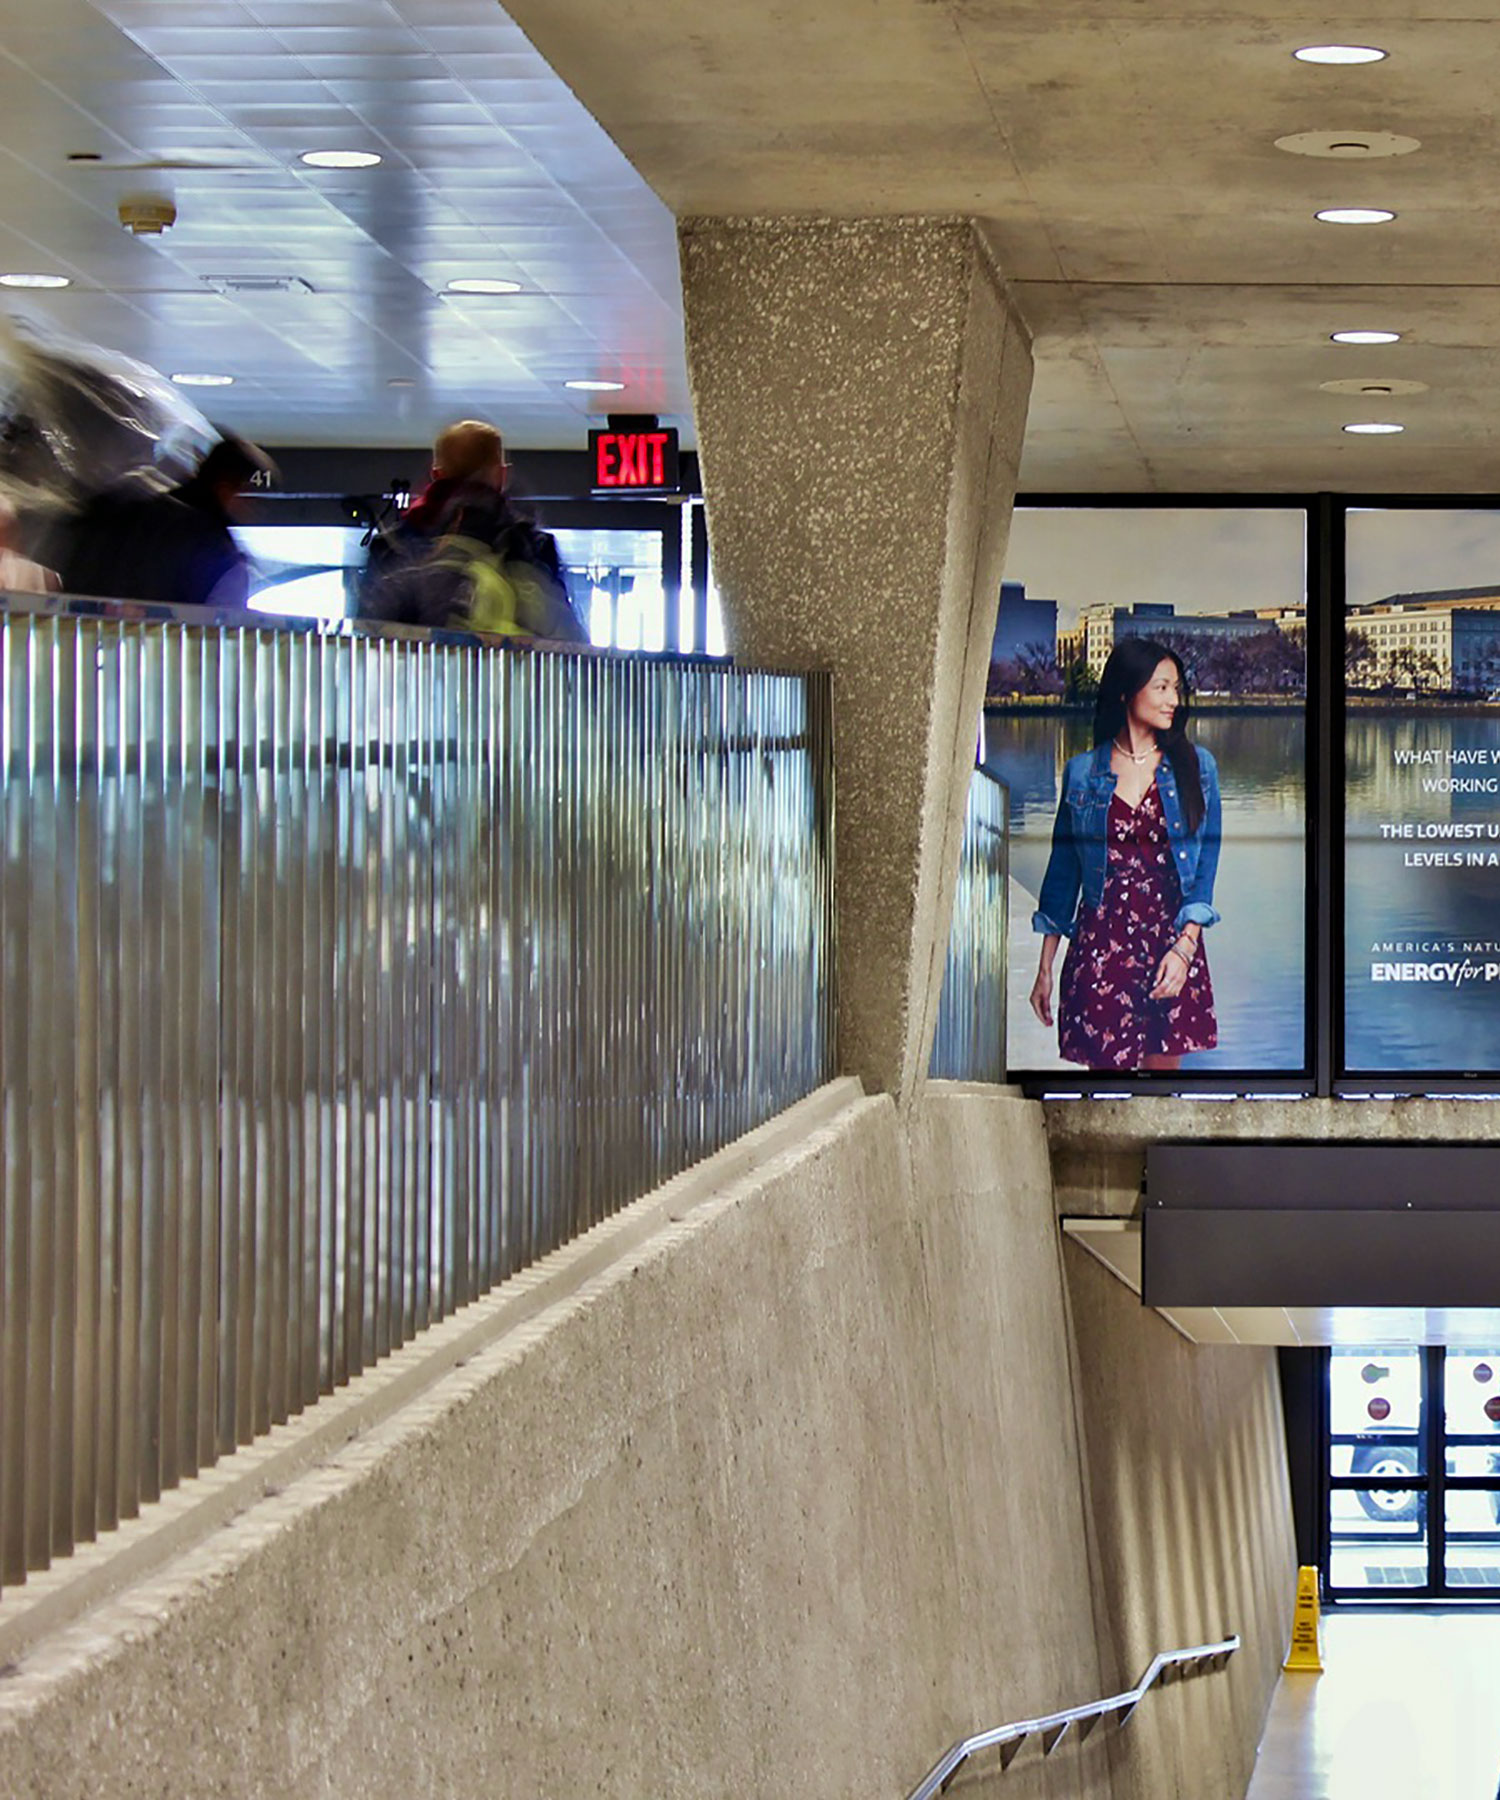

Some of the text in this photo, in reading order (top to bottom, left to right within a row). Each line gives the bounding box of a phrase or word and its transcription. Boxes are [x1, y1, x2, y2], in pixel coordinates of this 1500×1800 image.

[597, 432, 668, 486] EXIT
[250, 469, 271, 488] 41
[1394, 750, 1442, 764] WHAT
[1446, 750, 1487, 764] HAVE
[1422, 778, 1498, 793] WORKING
[1380, 824, 1414, 838] THE
[1417, 824, 1485, 838] LOWEST
[1404, 853, 1463, 867] LEVELS
[1467, 853, 1484, 867] IN
[1487, 853, 1499, 867] A
[1371, 942, 1455, 953] AMERICA'S
